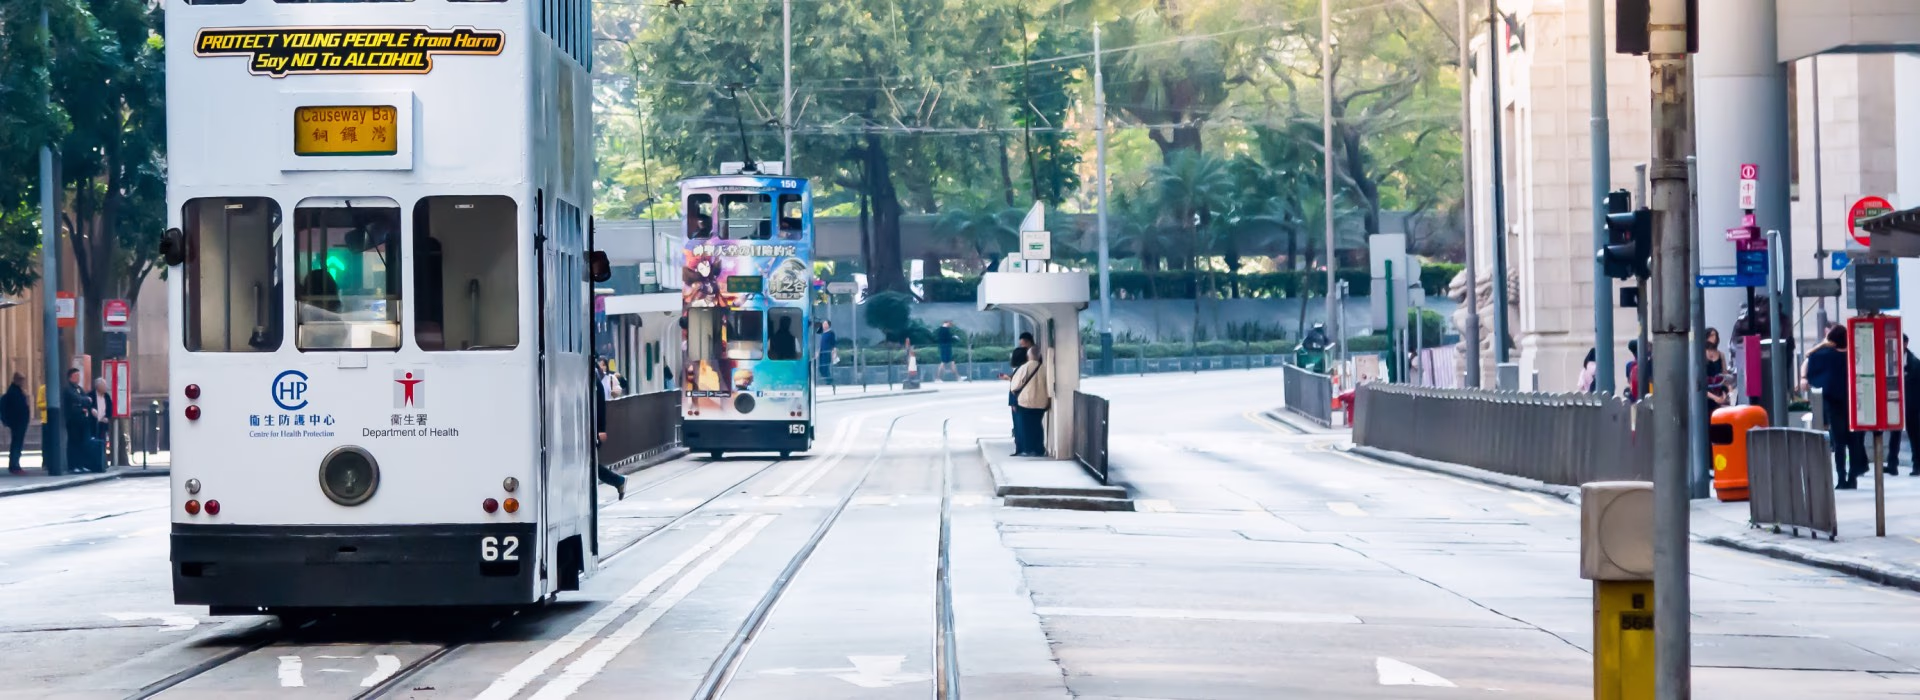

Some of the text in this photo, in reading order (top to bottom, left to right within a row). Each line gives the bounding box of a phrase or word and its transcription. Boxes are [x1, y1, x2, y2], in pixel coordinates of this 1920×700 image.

[201, 32, 498, 49] PROTECT YOUNG PEOPLE from Harm
[255, 52, 425, 70] Say NO To ALCOHOL
[301, 106, 396, 124] Causeway Bay
[312, 125, 387, 143] 銅鑼灣
[780, 180, 797, 189] 150
[249, 430, 269, 438] Centre
[270, 430, 279, 438] for
[362, 428, 459, 439] Department of Health
[788, 424, 806, 434] 150
[481, 535, 519, 561] 62
